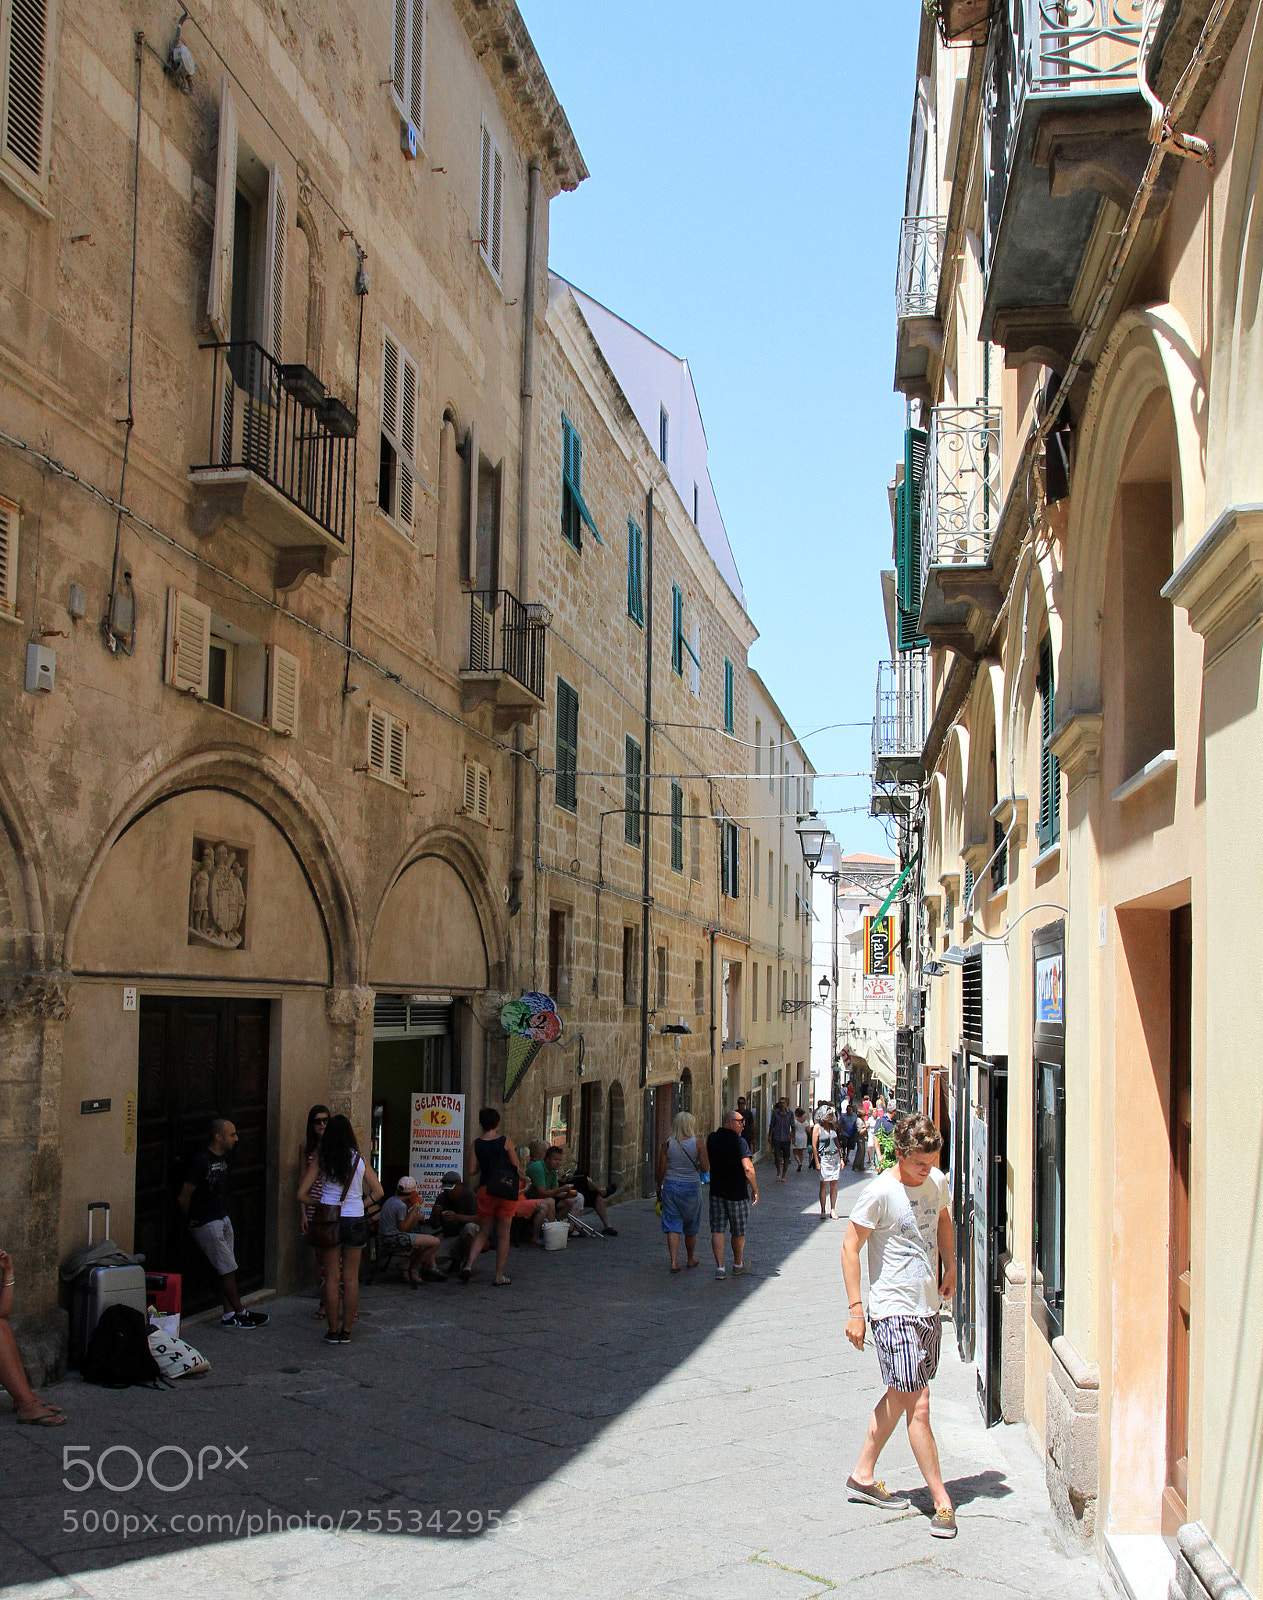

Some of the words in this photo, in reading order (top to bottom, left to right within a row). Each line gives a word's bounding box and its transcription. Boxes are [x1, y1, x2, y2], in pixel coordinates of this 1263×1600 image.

[864, 979, 895, 992] PIZZERIA
[517, 1012, 547, 1029] K2
[415, 1095, 461, 1112] GELATERIA
[430, 1110, 447, 1125] K2
